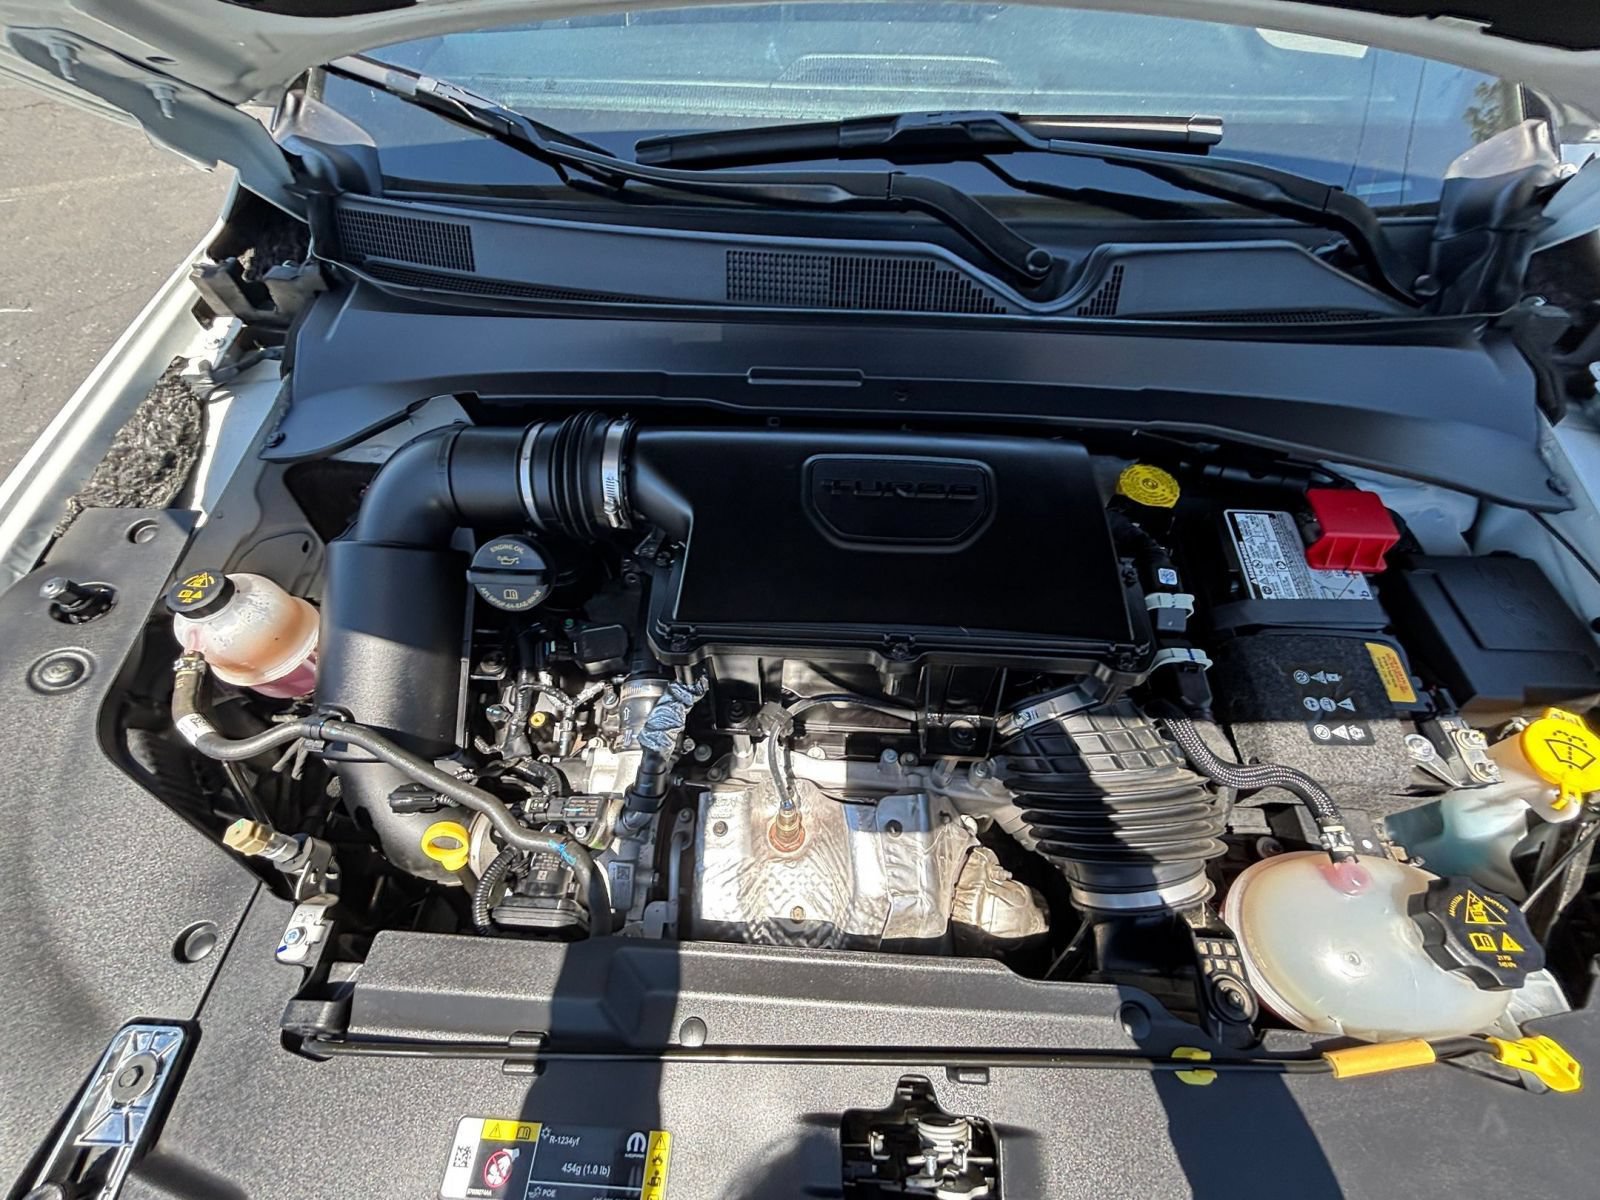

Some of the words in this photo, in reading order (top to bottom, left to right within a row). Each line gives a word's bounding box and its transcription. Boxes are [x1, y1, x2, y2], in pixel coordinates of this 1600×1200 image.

[820, 479, 978, 500] TURBO
[490, 544, 513, 552] ENGINE
[513, 545, 524, 554] OIL
[549, 1135, 581, 1147] R-1234yf
[561, 1162, 582, 1176] 454g
[582, 1164, 598, 1176] (1.0
[599, 1165, 611, 1178] lb)
[542, 1188, 557, 1198] POE
